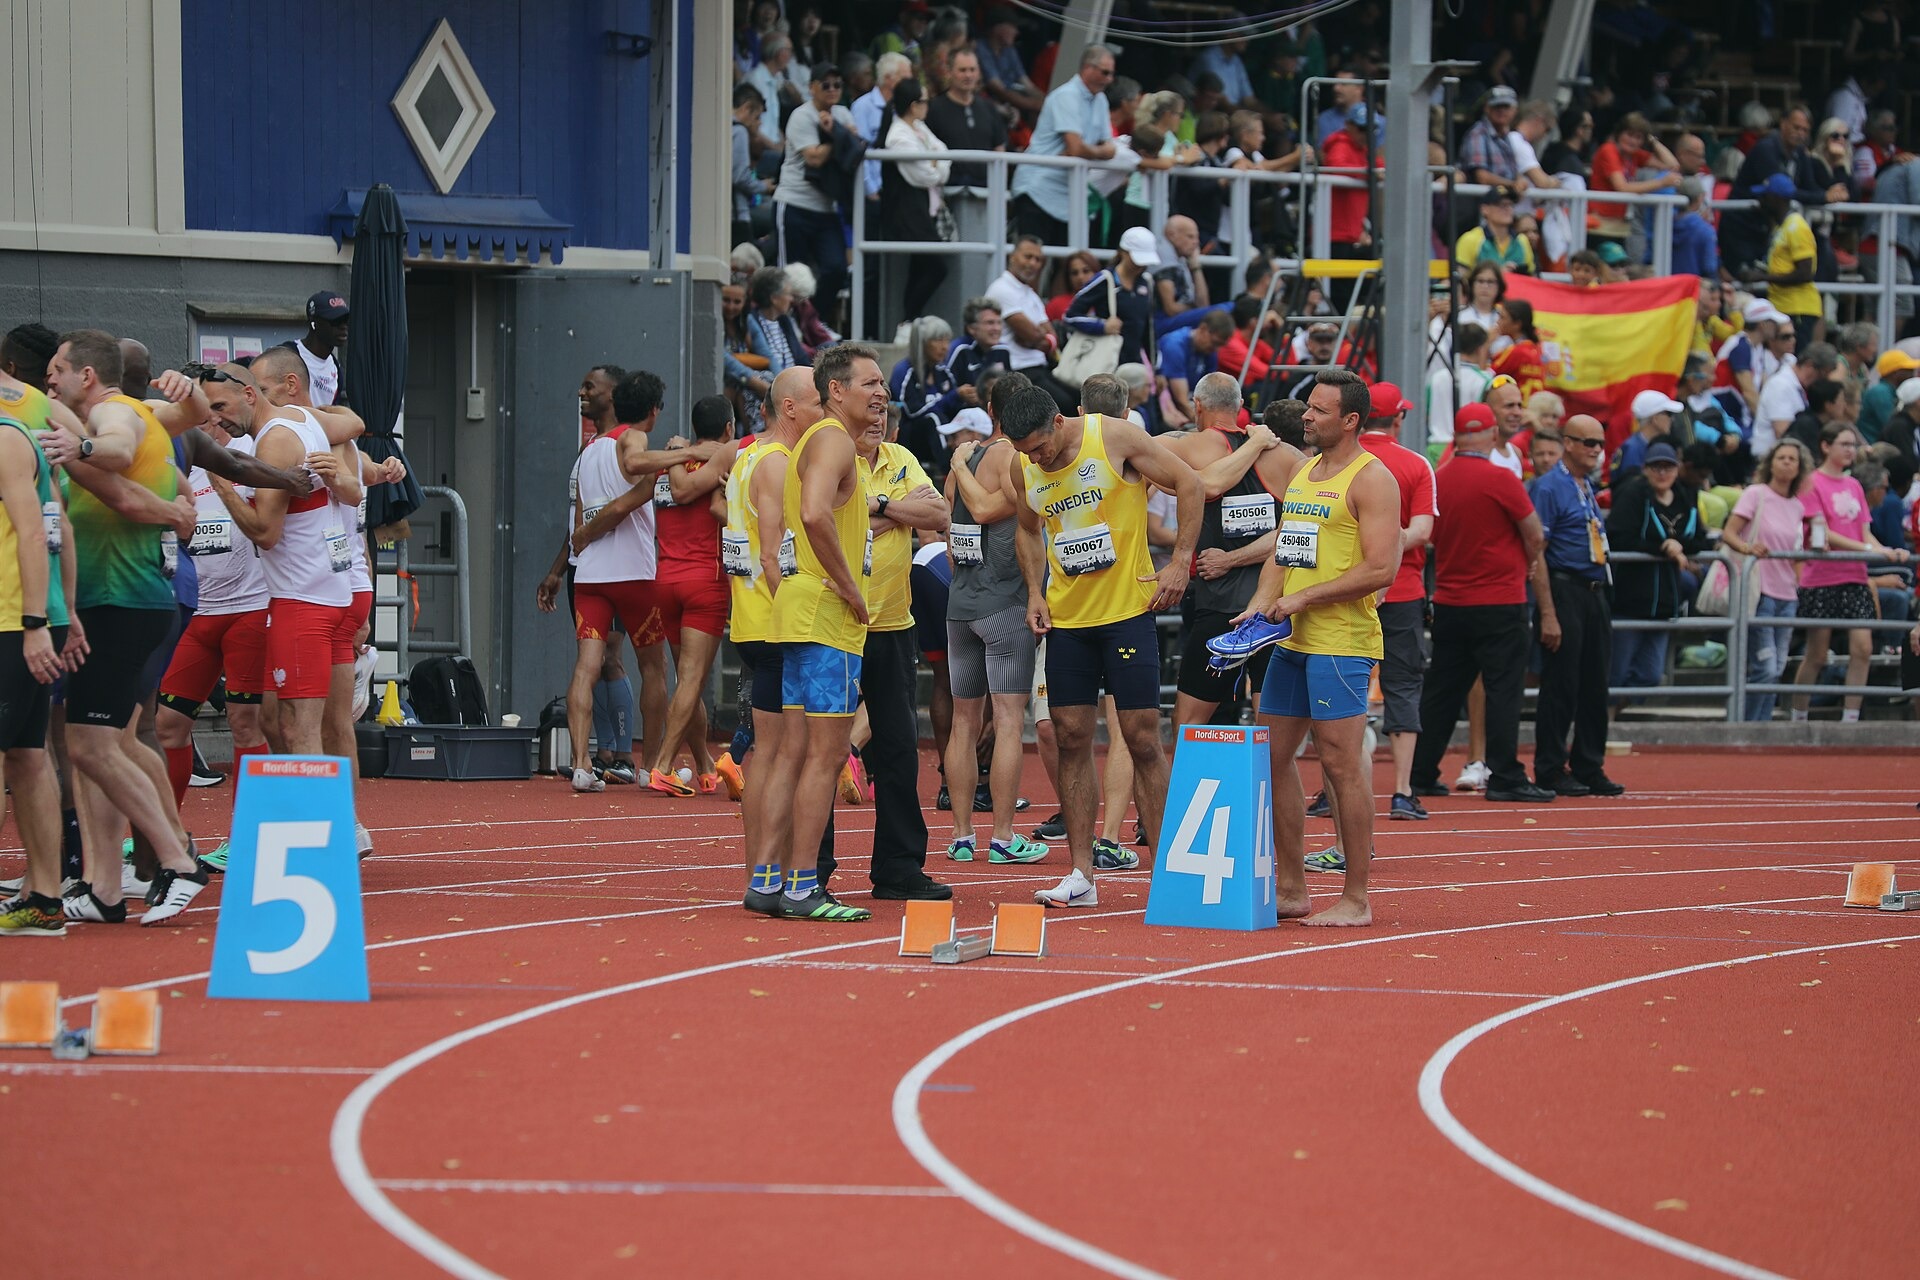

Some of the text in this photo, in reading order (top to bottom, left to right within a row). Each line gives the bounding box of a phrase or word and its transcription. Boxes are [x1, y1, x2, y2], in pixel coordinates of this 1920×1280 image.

[1036, 482, 1055, 494] CRAFT
[1045, 488, 1103, 518] SWEDEN
[1282, 501, 1331, 519] SWEDEN
[1228, 506, 1267, 519] 450506
[1063, 538, 1103, 556] 450067
[1281, 535, 1310, 547] 450468
[1219, 731, 1241, 743] Sport
[299, 762, 331, 777] Sport
[1165, 778, 1235, 905] 4
[1254, 780, 1272, 906] 4
[246, 820, 337, 975] 5
